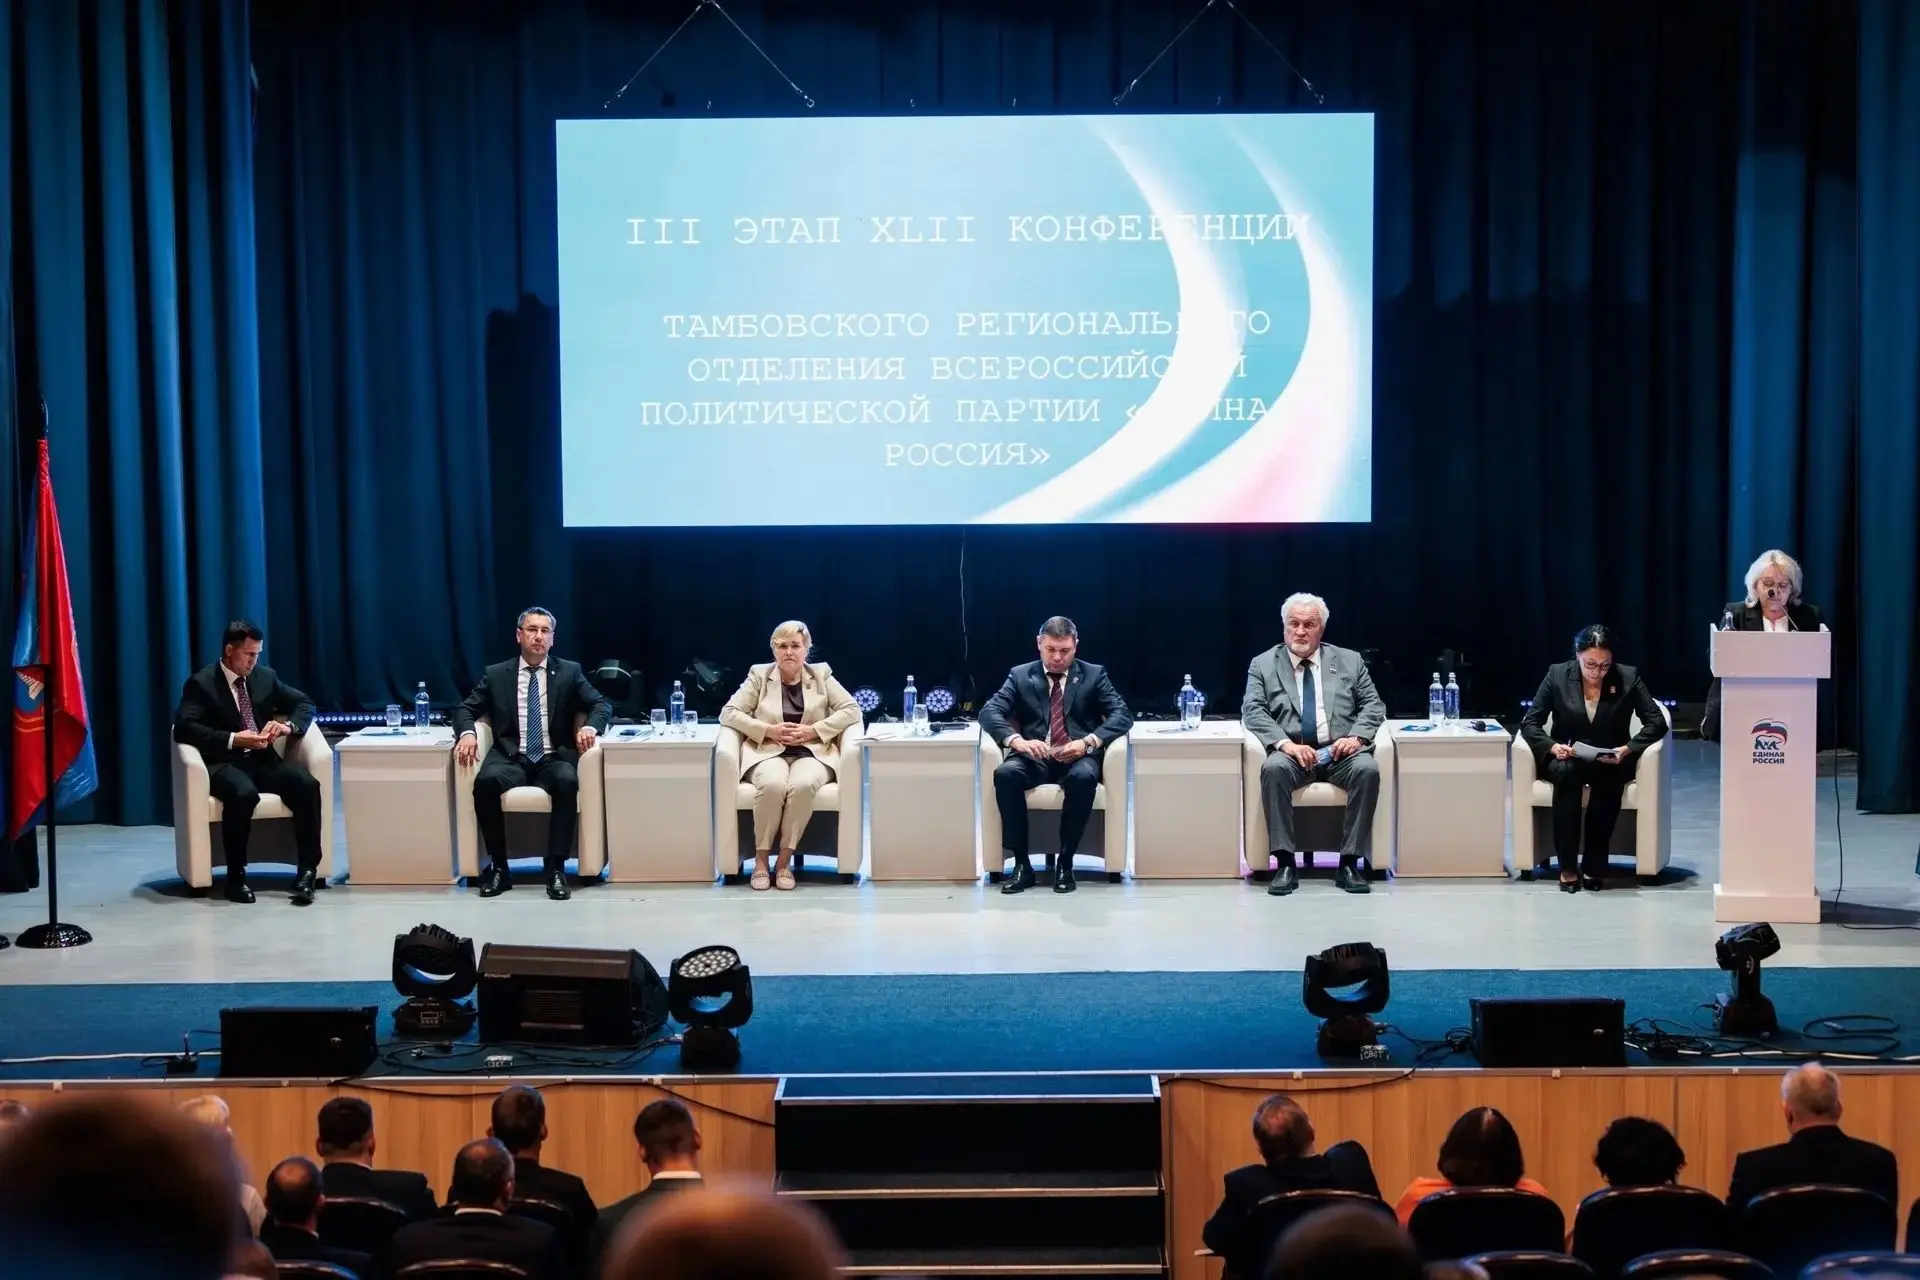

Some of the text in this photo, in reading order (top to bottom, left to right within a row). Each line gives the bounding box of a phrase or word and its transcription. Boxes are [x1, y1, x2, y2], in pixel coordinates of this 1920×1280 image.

[626, 214, 1312, 246] III ЭТАП XLII КОНФЕРНЦИИ
[663, 310, 1271, 339] ТАМБОВСКОГО РЕГИОНАЛЬГО
[687, 348, 1248, 386] ОТДЕЛЕНИЯ ВСЕРОССИЙС
[640, 393, 931, 426] ПОЛИТИЧЕСКОЙ
[955, 398, 1101, 423] ПАРТИИ
[885, 442, 1051, 467] РОССИЯ»
